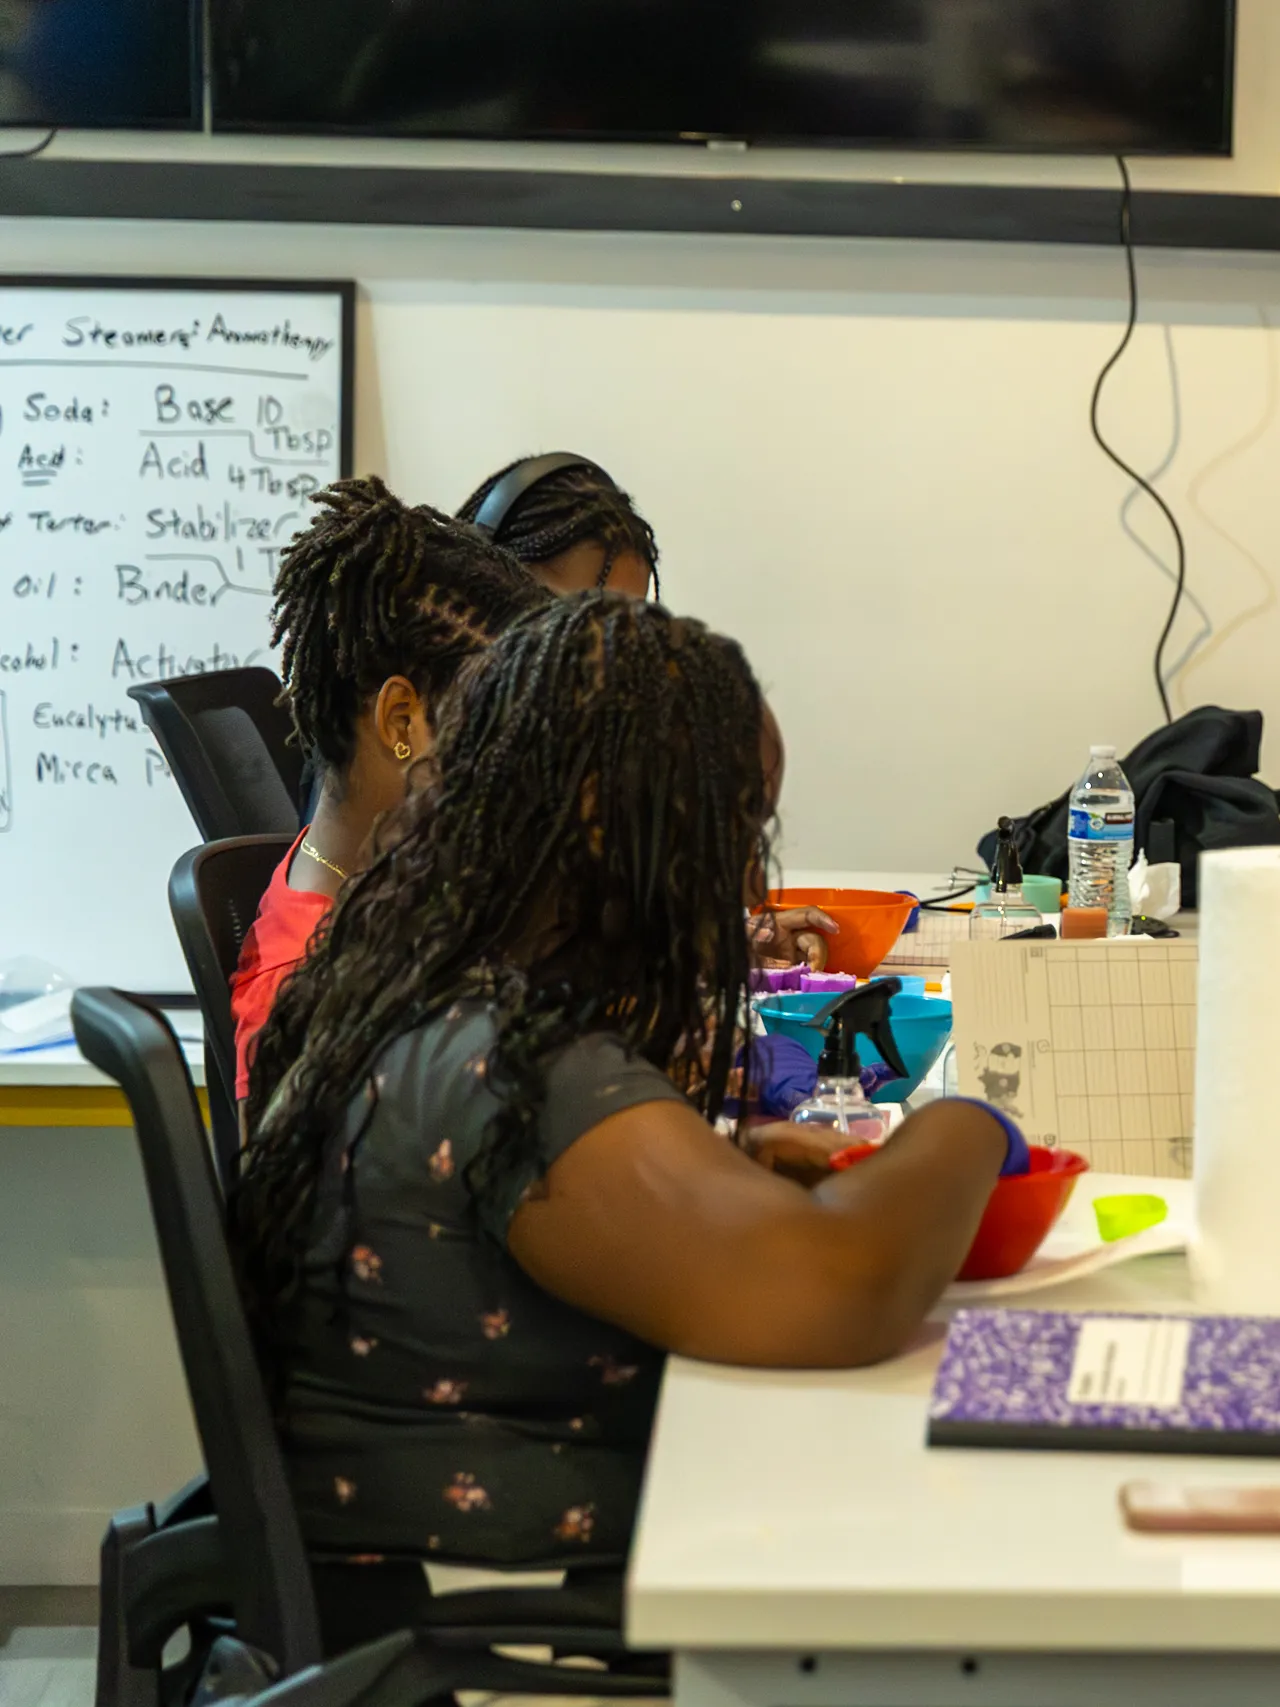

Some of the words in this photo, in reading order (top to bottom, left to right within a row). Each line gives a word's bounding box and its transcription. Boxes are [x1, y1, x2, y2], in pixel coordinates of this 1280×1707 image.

[0, 322, 34, 346] er
[154, 383, 236, 424] Base
[256, 394, 283, 426] 10
[139, 440, 209, 480] Acid
[228, 463, 246, 492] 4
